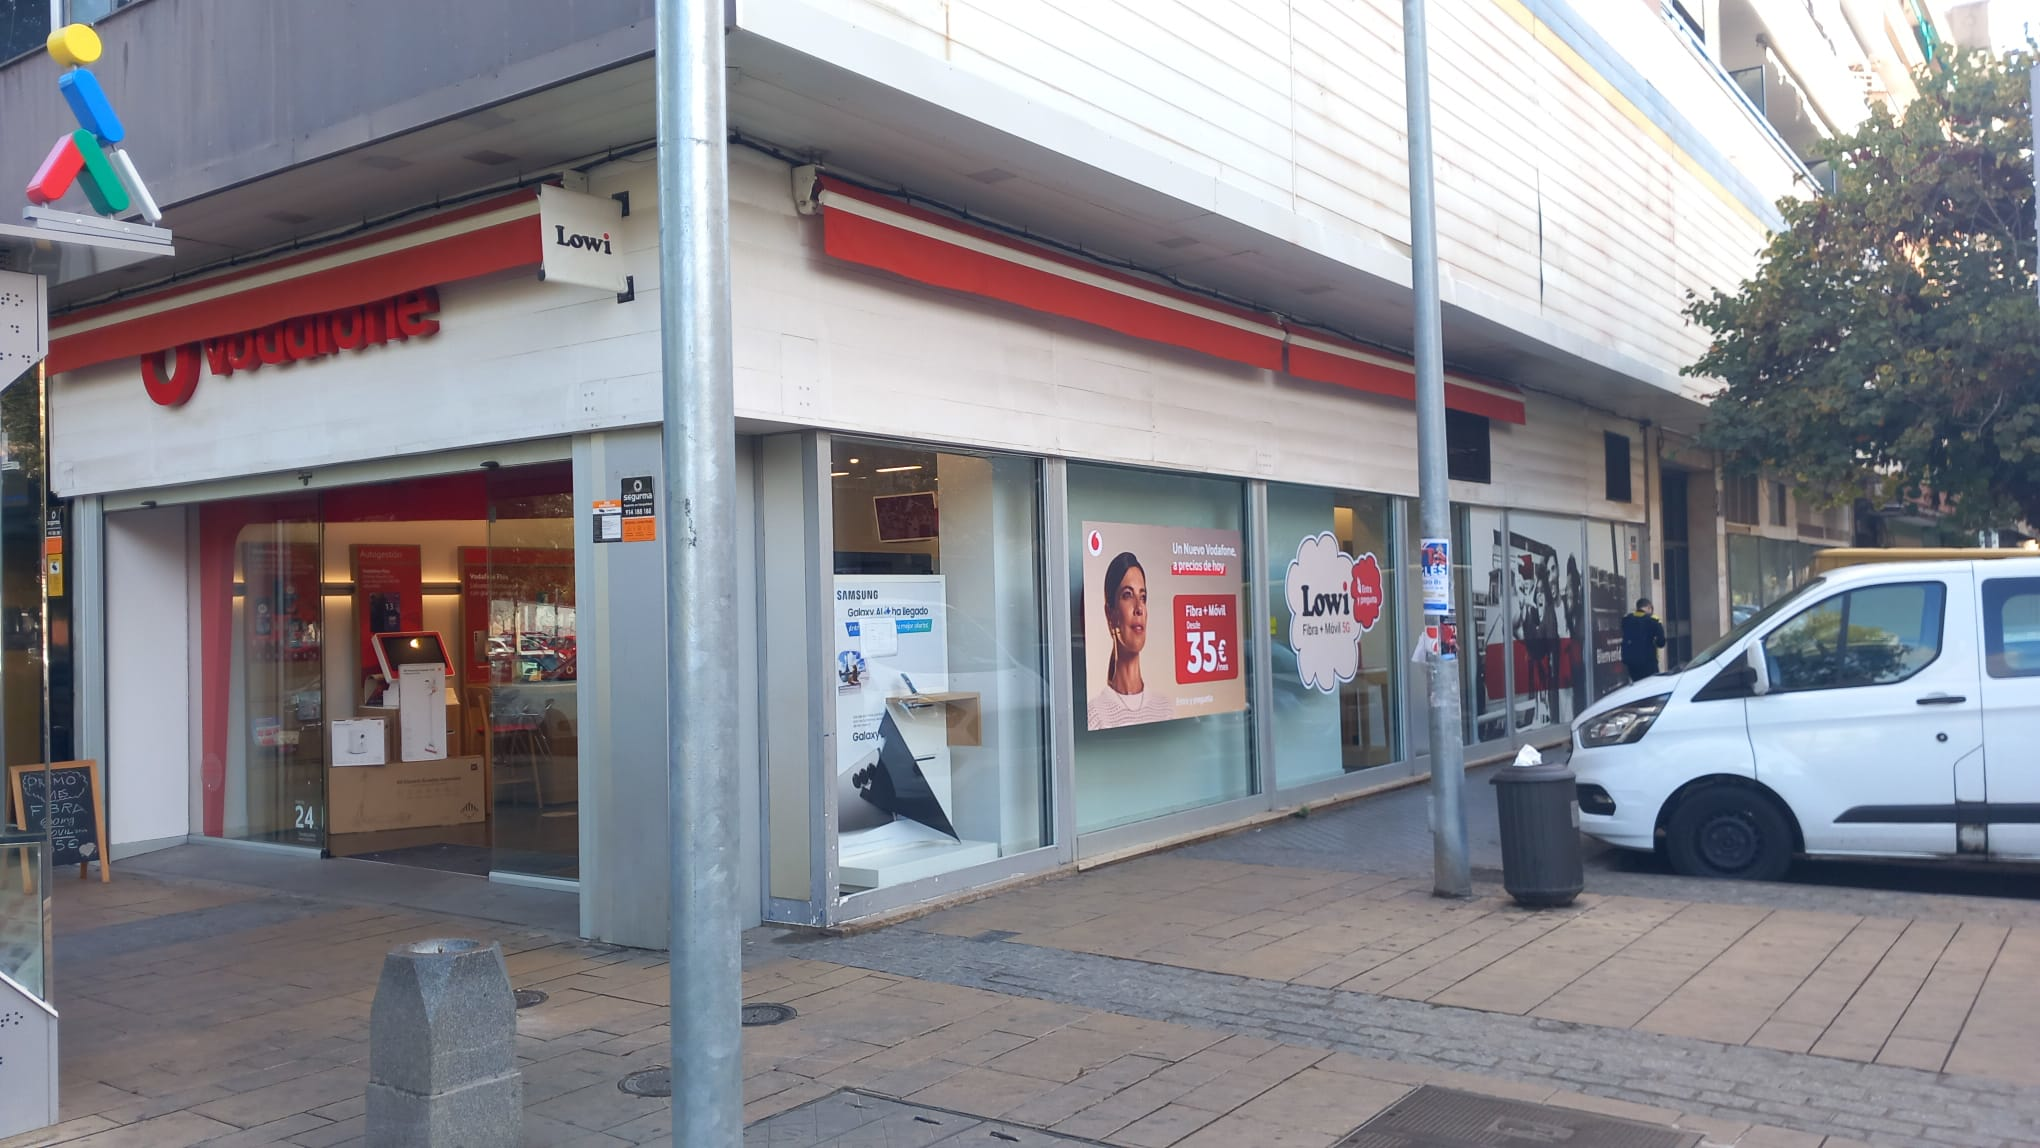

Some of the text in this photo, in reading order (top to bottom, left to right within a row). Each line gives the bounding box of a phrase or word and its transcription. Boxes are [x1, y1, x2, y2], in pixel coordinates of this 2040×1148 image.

[555, 224, 612, 255] Lowi
[623, 492, 652, 502] segurma
[360, 549, 403, 560] Autogestión
[1172, 542, 1183, 554] Un
[1183, 543, 1205, 555] Nuevo
[1173, 560, 1225, 574] a precios de hoy
[836, 590, 878, 601] SAMSUNG
[1301, 581, 1350, 616] Lowi
[847, 606, 929, 618] Galaxy AI ha llegado
[1185, 603, 1226, 616] Fibra + Móvil
[1186, 620, 1201, 629] Desde
[1302, 623, 1318, 636] Fibra
[1325, 622, 1341, 635] Móvil
[1342, 622, 1351, 634] 5G
[1186, 631, 1227, 674] 35€
[852, 730, 880, 742] Galaxy
[27, 775, 76, 792] PRMO
[30, 802, 87, 817] FBRA
[295, 805, 314, 829] 24
[50, 829, 74, 837] OVIL
